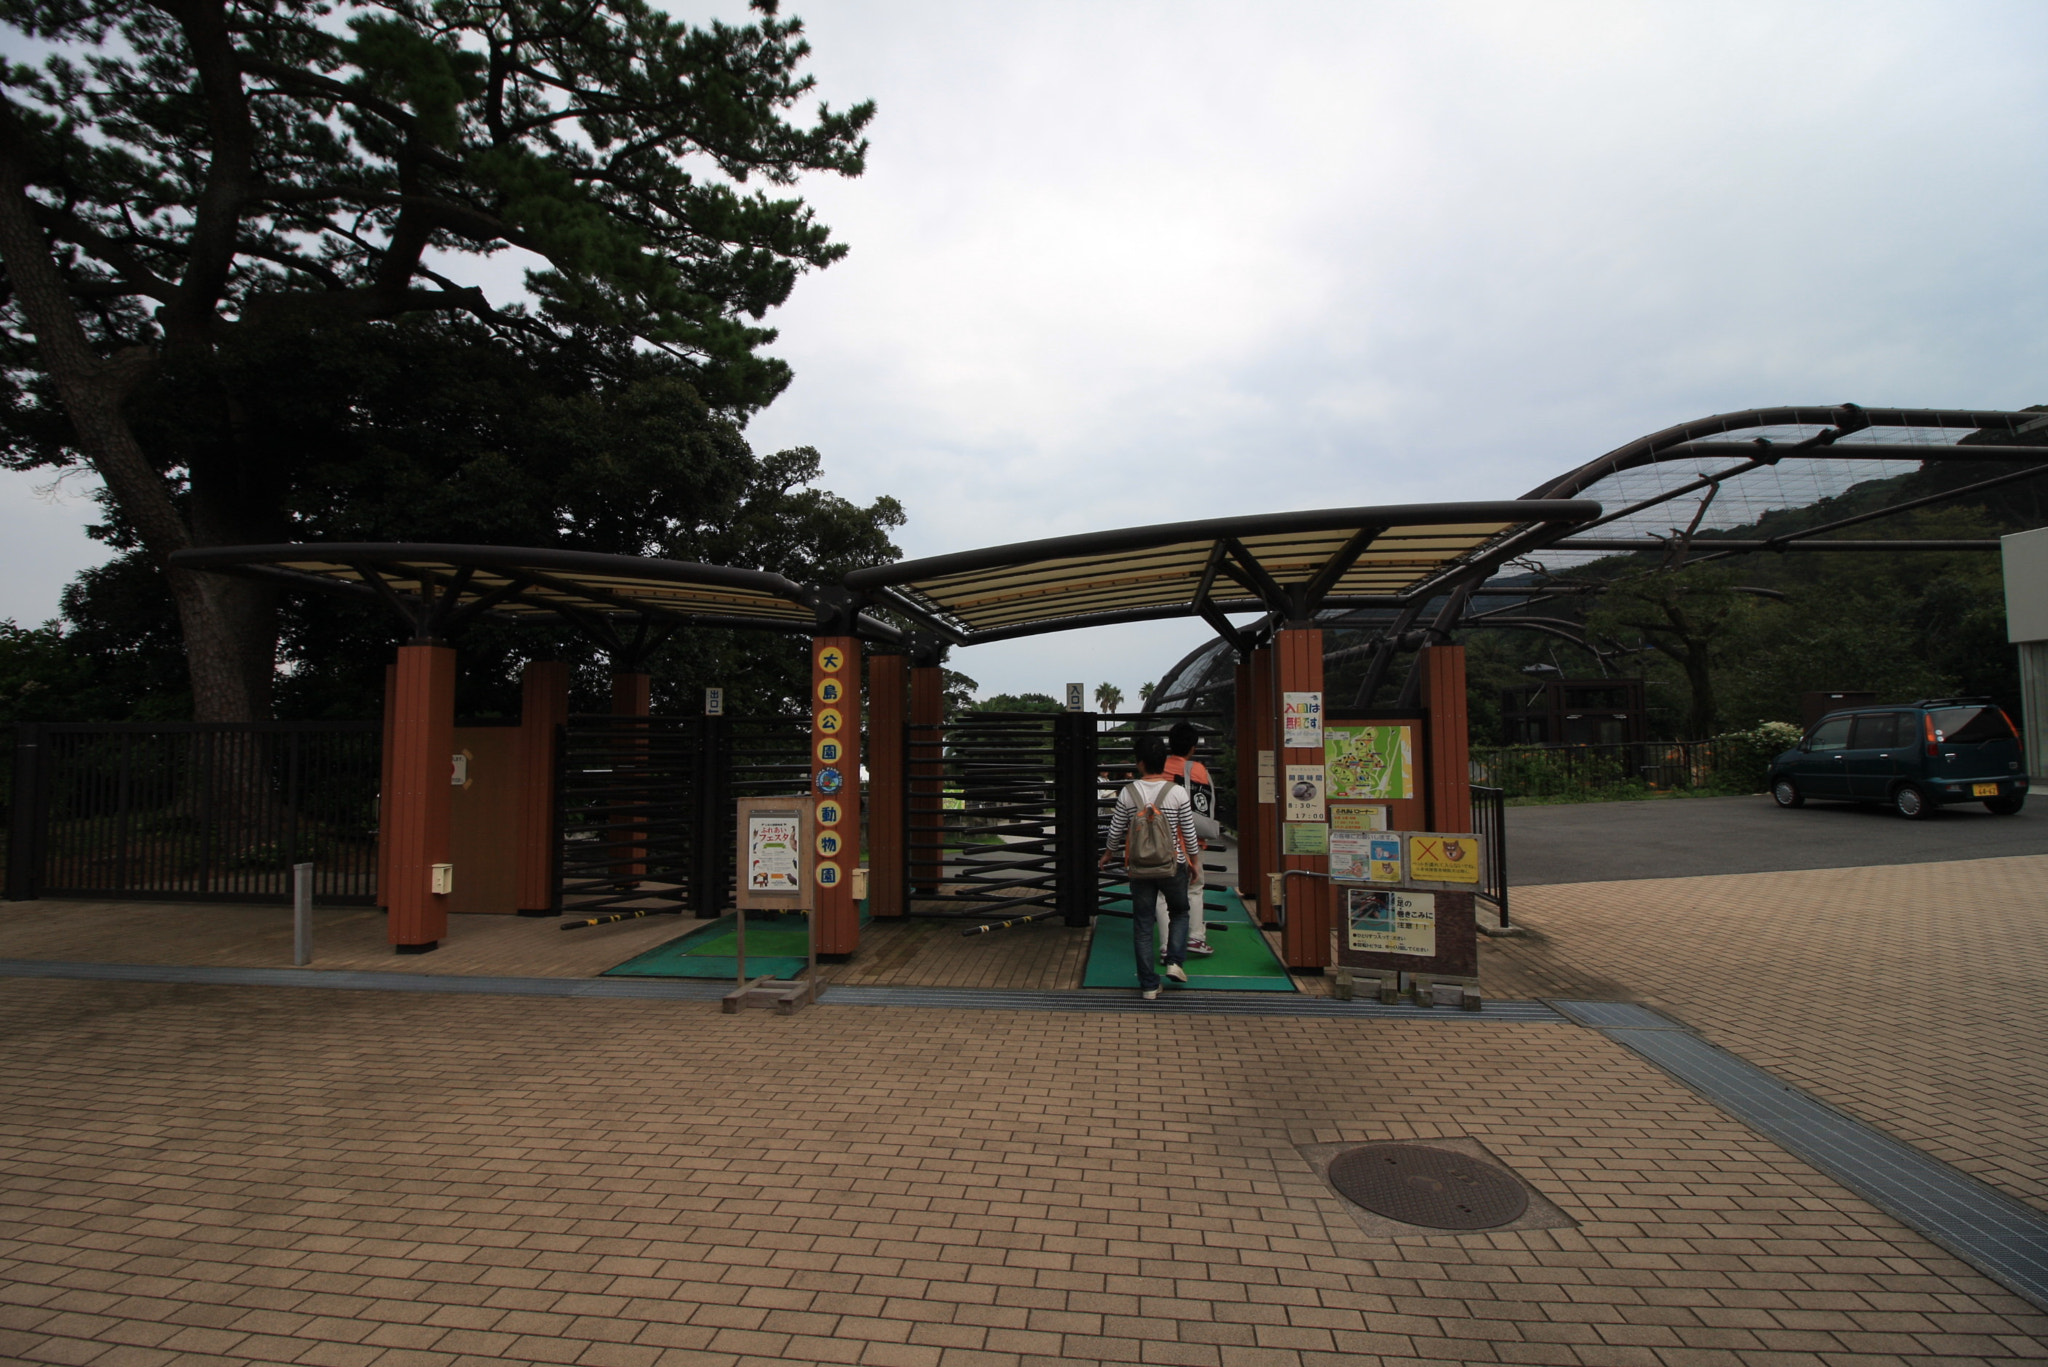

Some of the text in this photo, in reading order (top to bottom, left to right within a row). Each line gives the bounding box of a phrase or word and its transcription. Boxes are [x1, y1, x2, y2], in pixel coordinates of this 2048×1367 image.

[710, 690, 719, 708] 出口
[1070, 685, 1080, 704] 入口
[822, 653, 838, 760] 大島公園
[759, 833, 789, 842] フェスタ
[821, 806, 837, 884] 動物園
[1397, 910, 1434, 919] 巻きこみに
